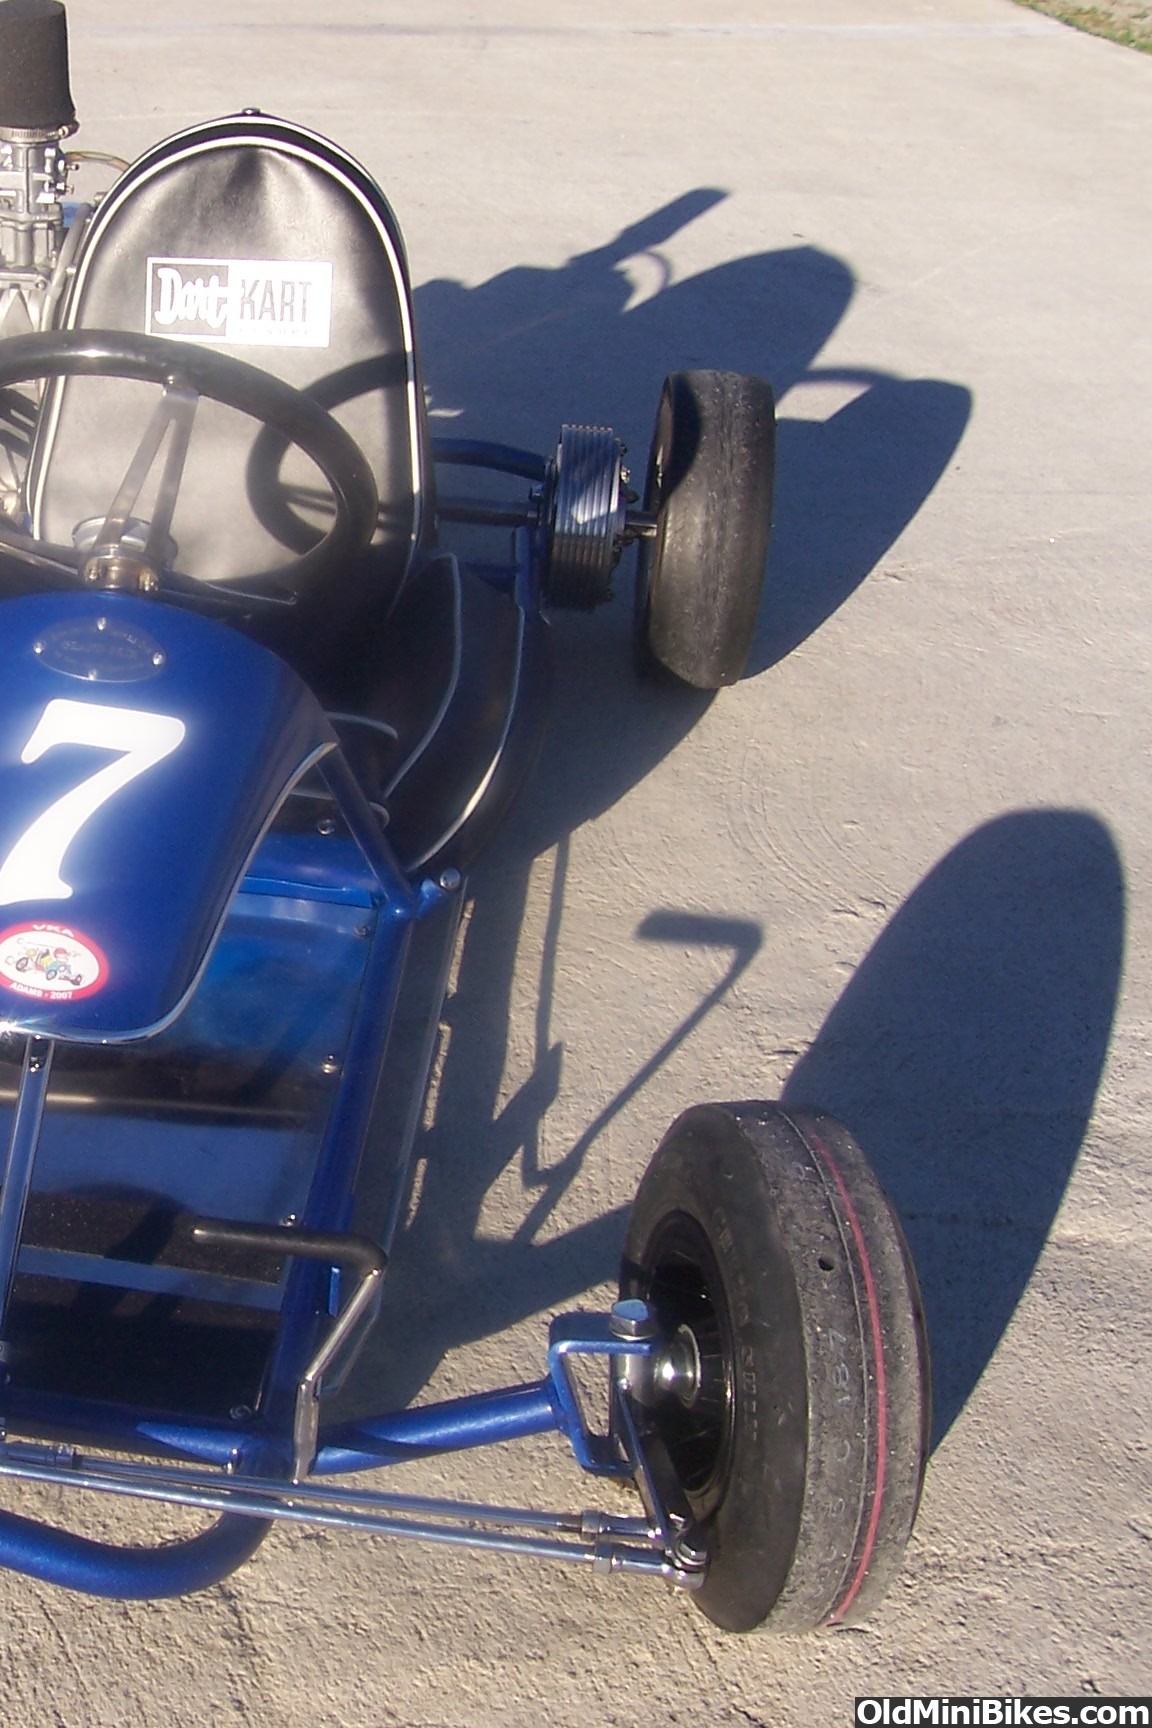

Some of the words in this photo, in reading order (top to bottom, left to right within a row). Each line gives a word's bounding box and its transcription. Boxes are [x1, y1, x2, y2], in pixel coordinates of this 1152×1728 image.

[239, 279, 313, 322] KART
[9, 981, 44, 998] ADAMS
[50, 990, 74, 1000] 2007
